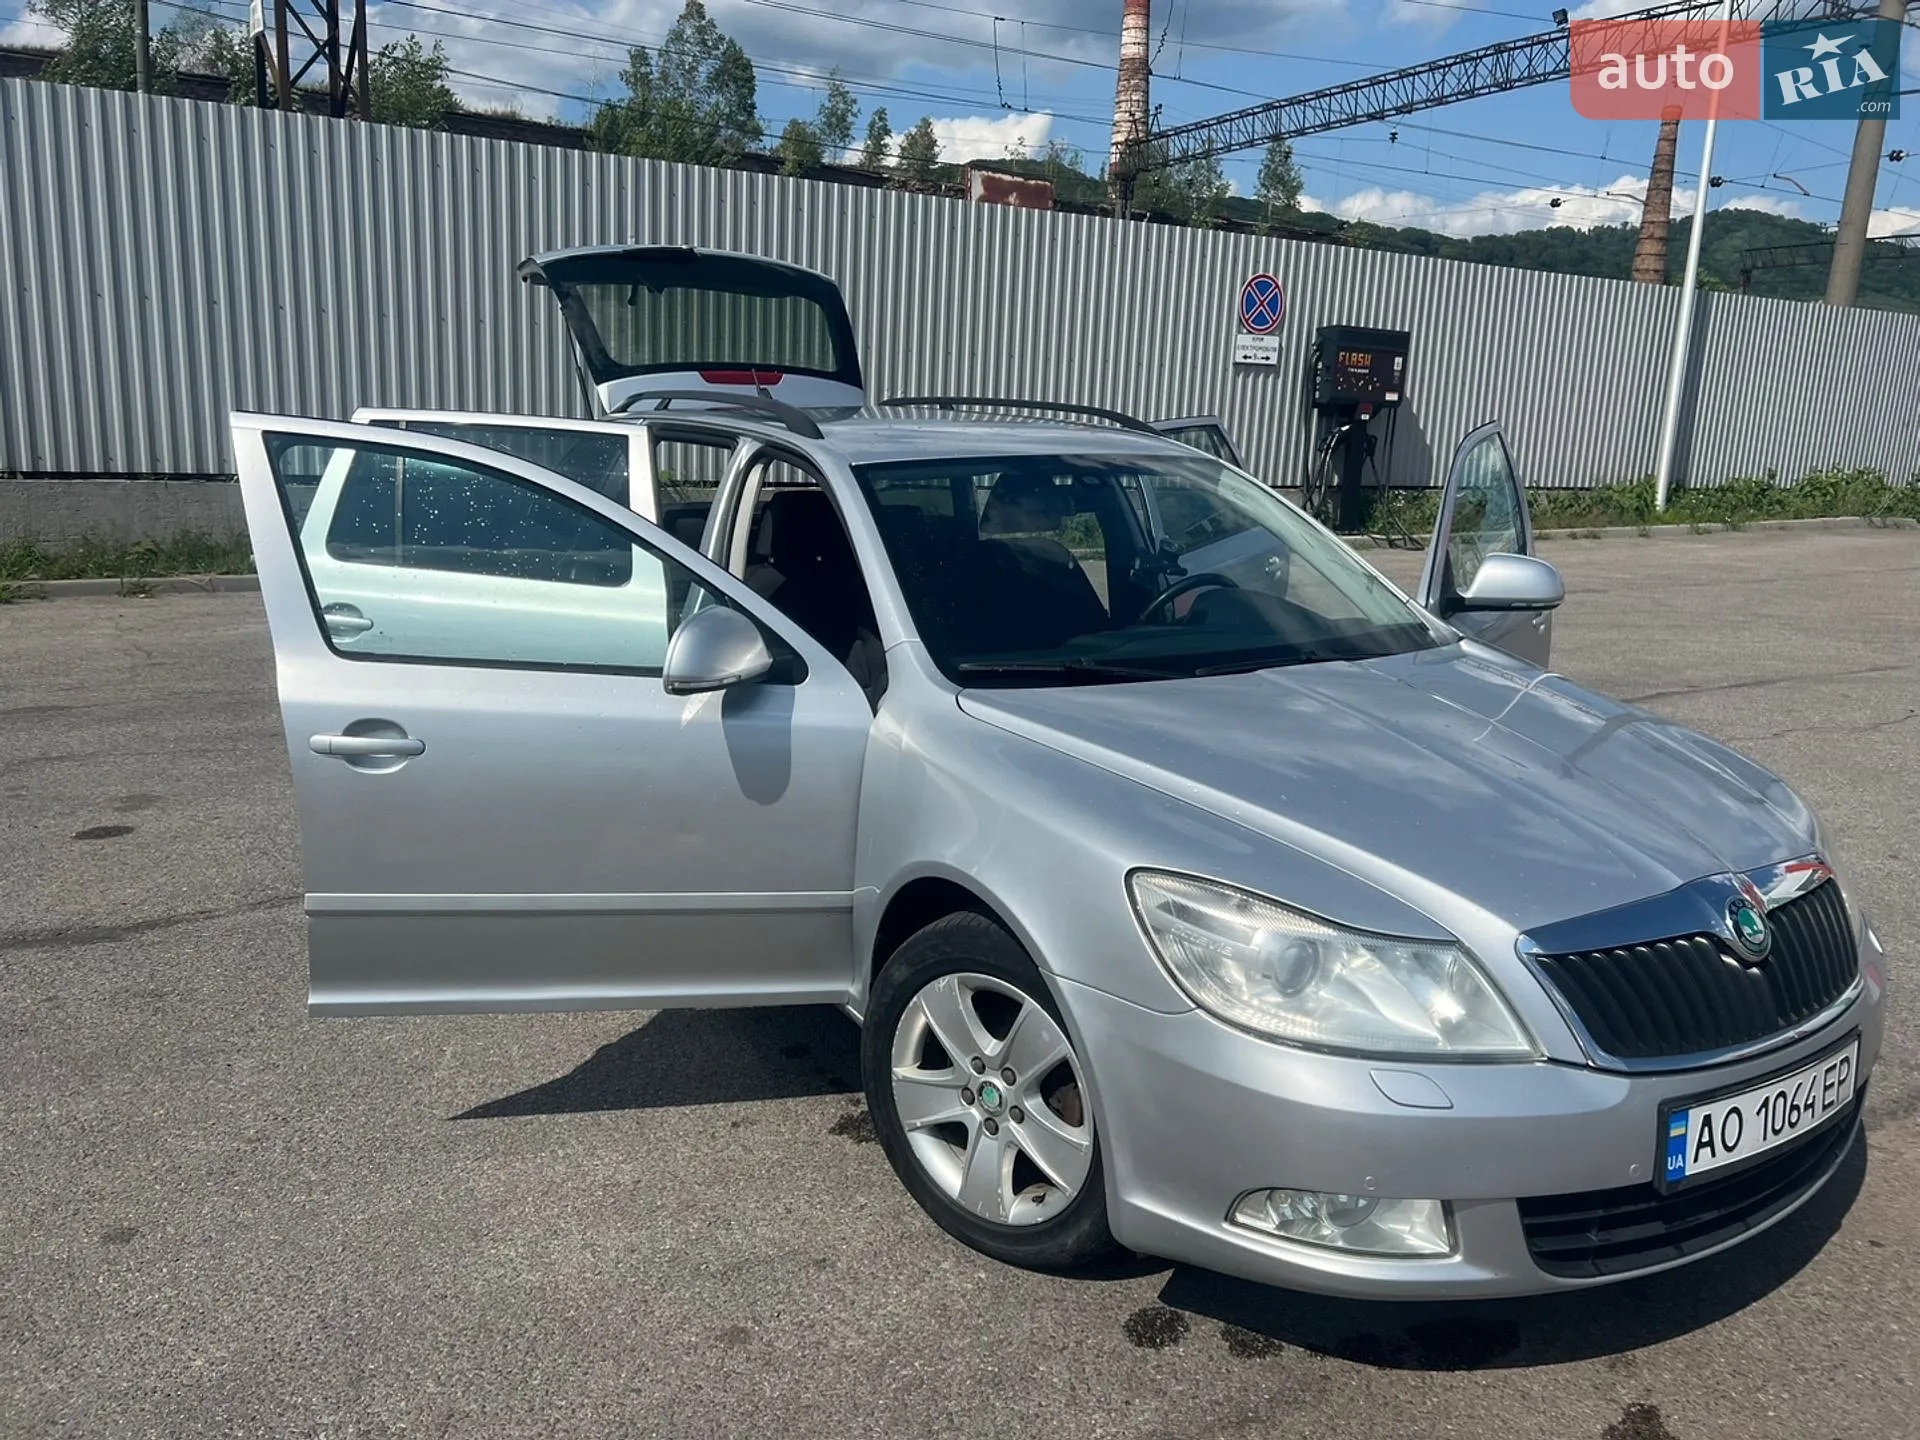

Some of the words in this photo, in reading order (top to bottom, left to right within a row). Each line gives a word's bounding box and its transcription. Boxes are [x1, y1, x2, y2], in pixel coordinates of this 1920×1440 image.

[1693, 1105, 1743, 1164] AO
[1756, 1072, 1817, 1141] 1064
[1821, 1055, 1851, 1112] EP
[1667, 1154, 1684, 1171] UA
